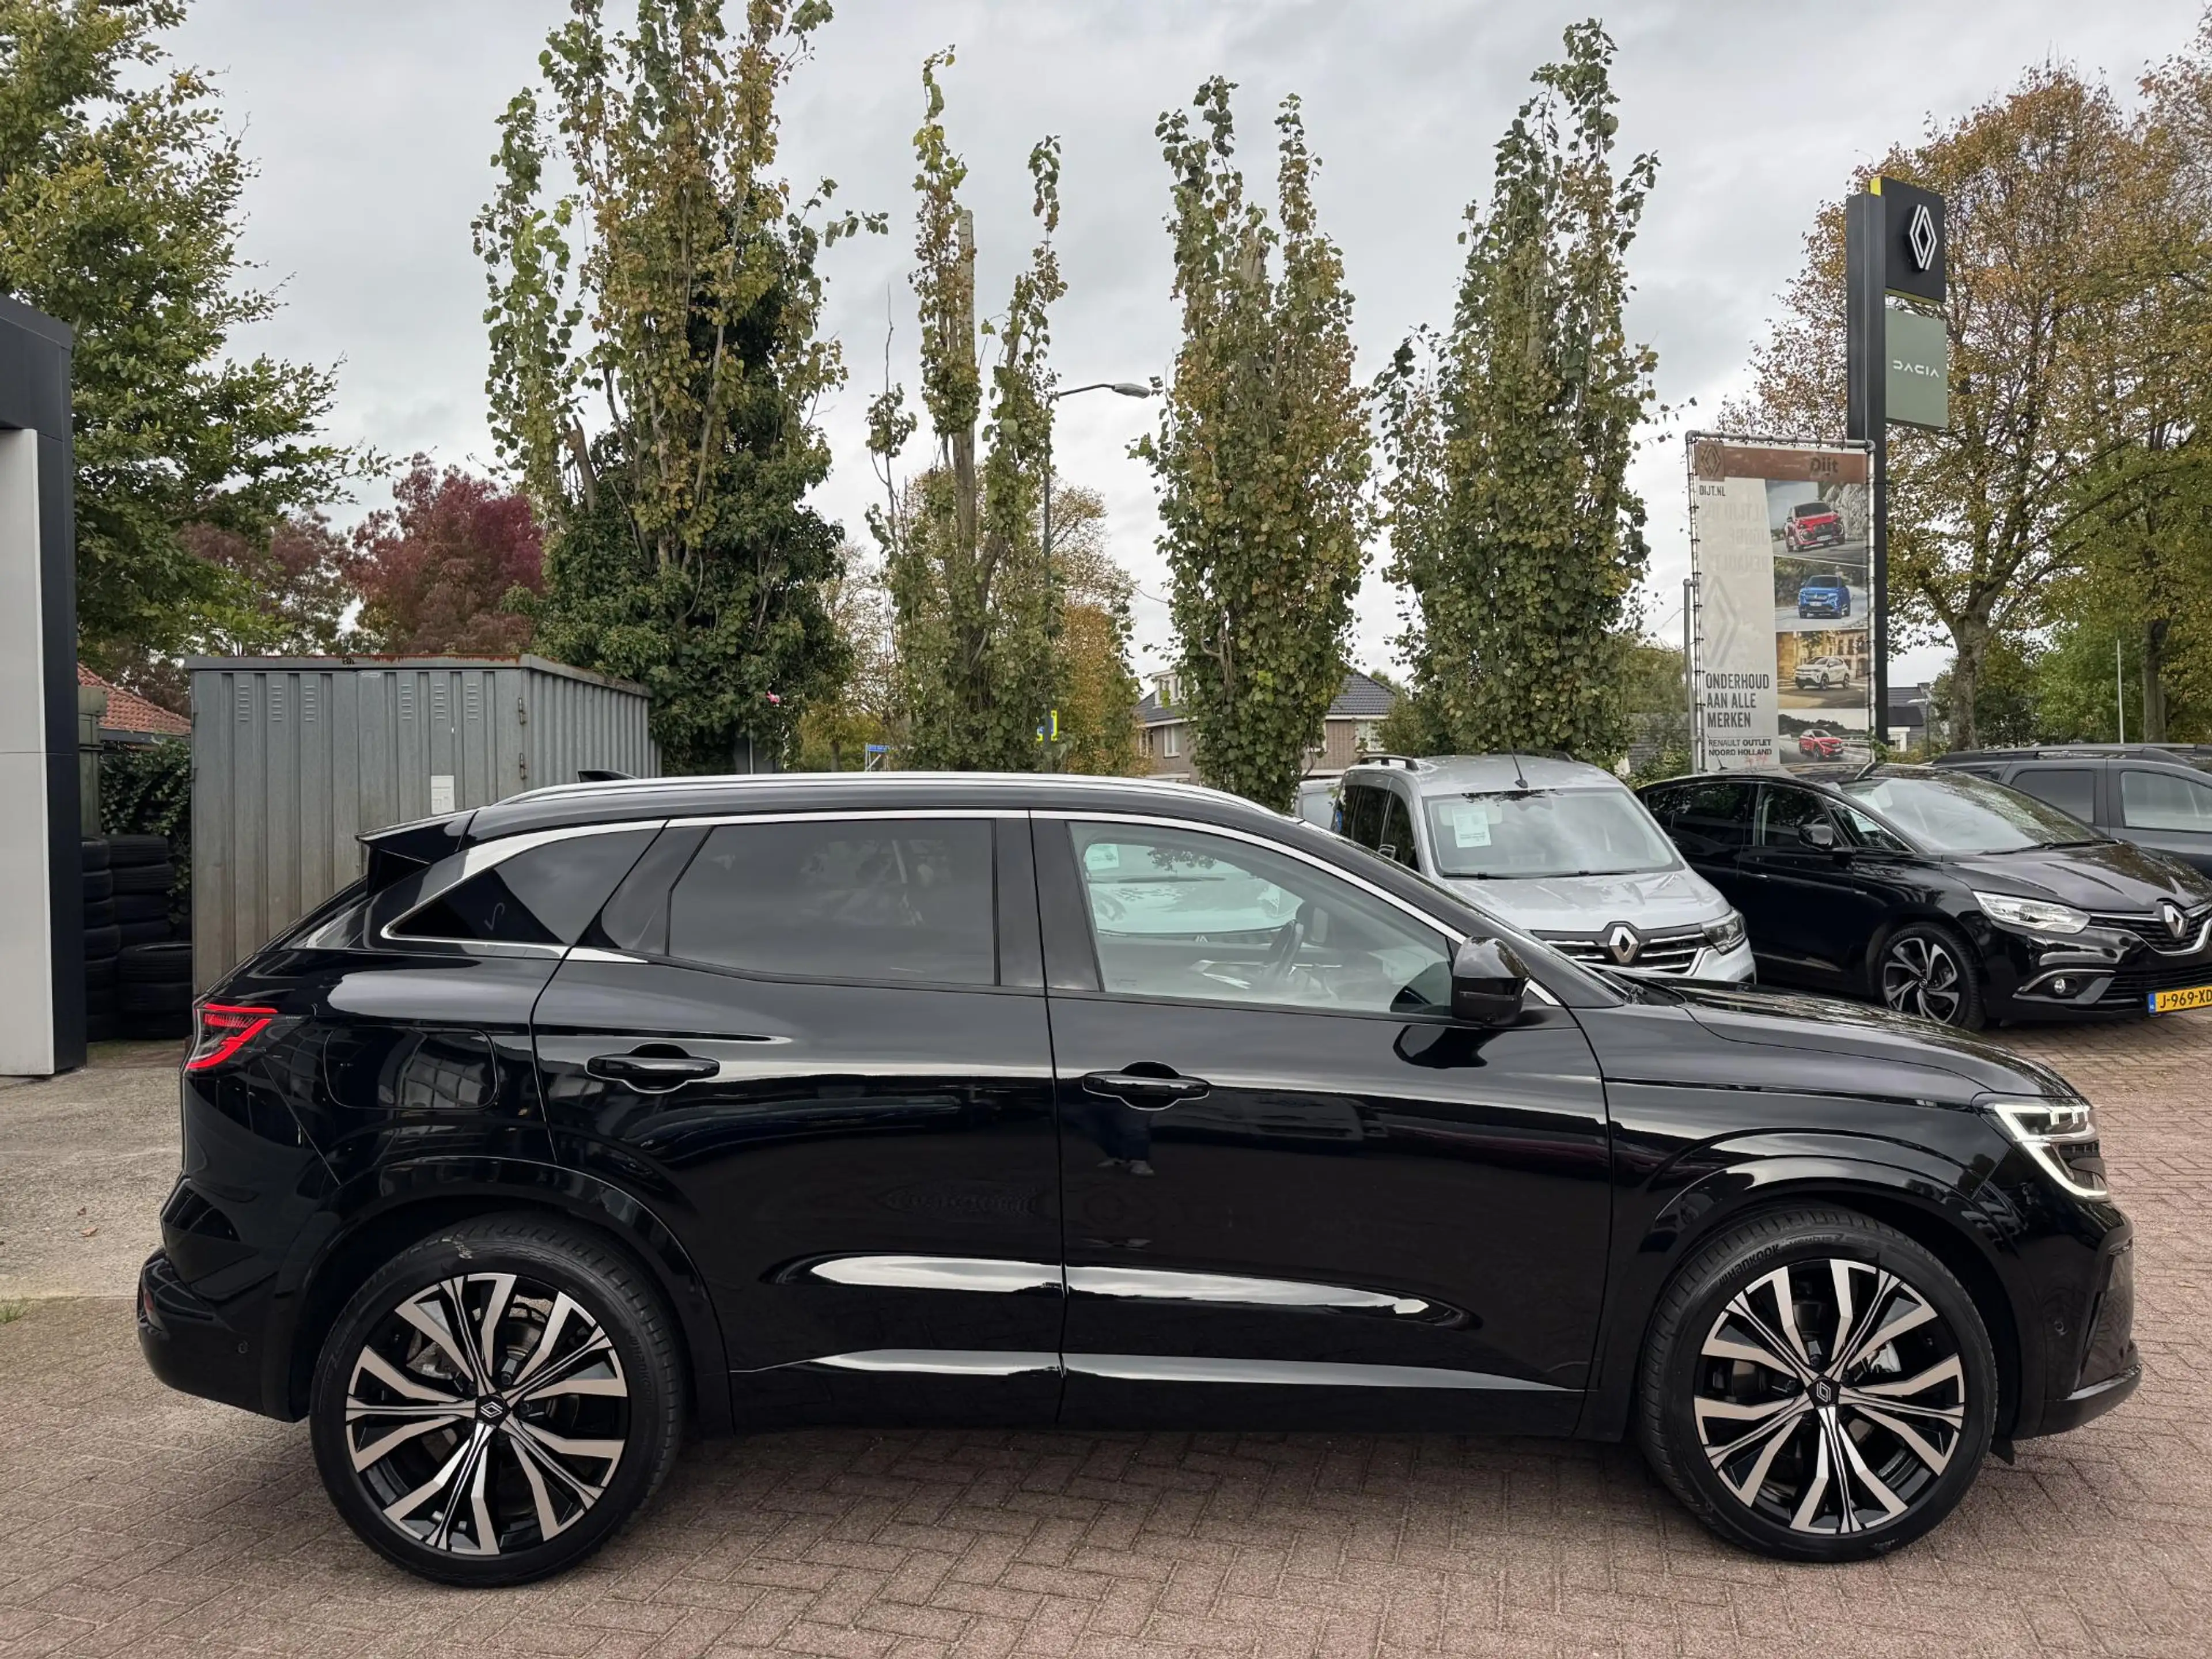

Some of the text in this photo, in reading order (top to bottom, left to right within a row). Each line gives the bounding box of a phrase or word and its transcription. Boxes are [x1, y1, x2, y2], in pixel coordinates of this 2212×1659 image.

[1892, 359, 1940, 378] DACIA
[1699, 484, 1726, 497] DIJT.NL
[1706, 673, 1770, 690] ONDERHOUD
[1706, 692, 1756, 709] AAN ALLE
[1707, 711, 1751, 728] MERKEN
[1709, 738, 1772, 747] RENAULT OUTLET
[2160, 990, 2212, 1008] J-969-XD
